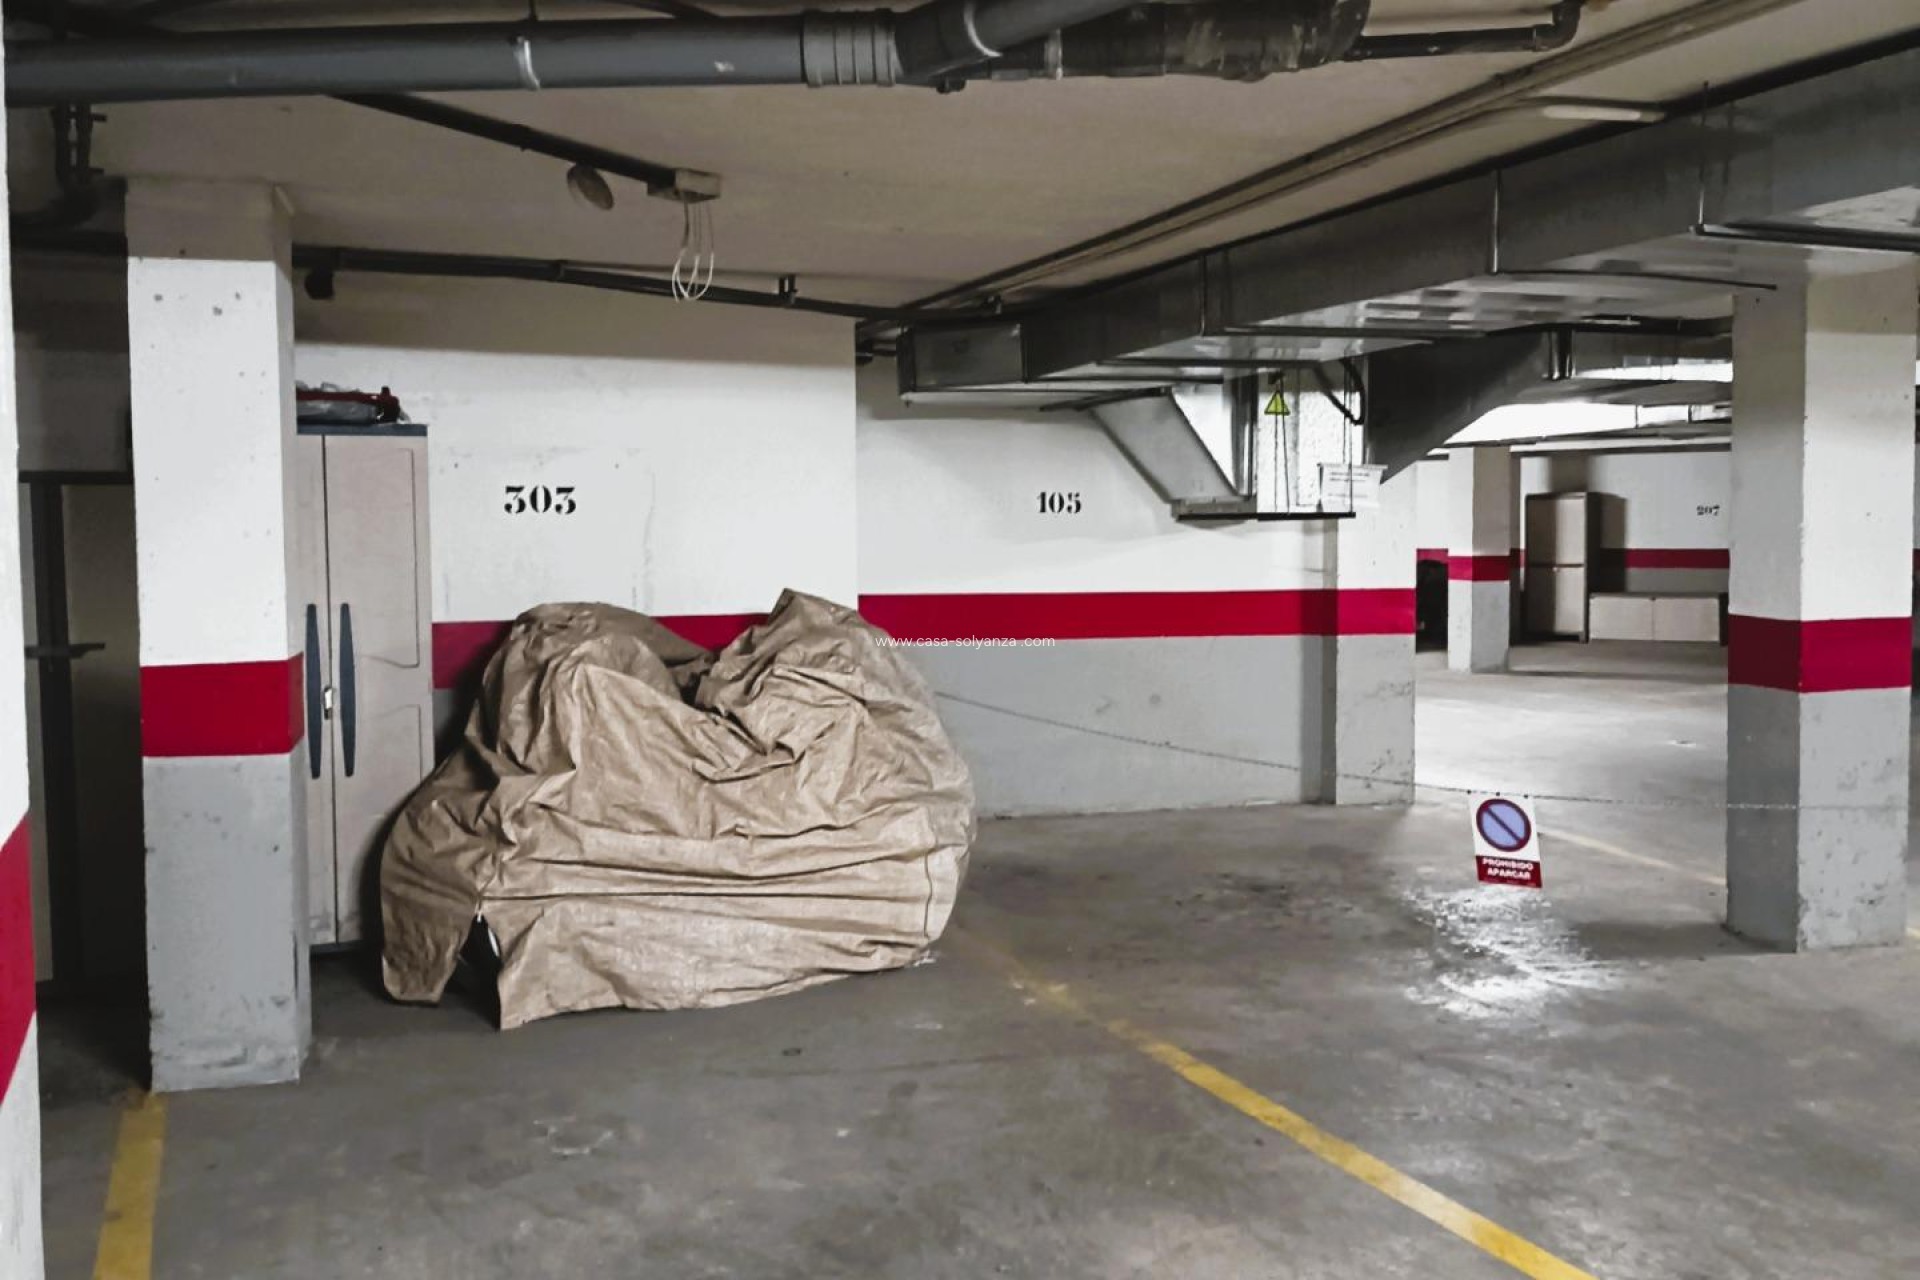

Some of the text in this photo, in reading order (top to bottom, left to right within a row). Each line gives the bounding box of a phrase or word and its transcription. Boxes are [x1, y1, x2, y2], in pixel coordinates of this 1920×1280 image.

[504, 485, 576, 515] 303
[1037, 491, 1082, 514] 105
[1482, 858, 1534, 871] PROHIBIDO
